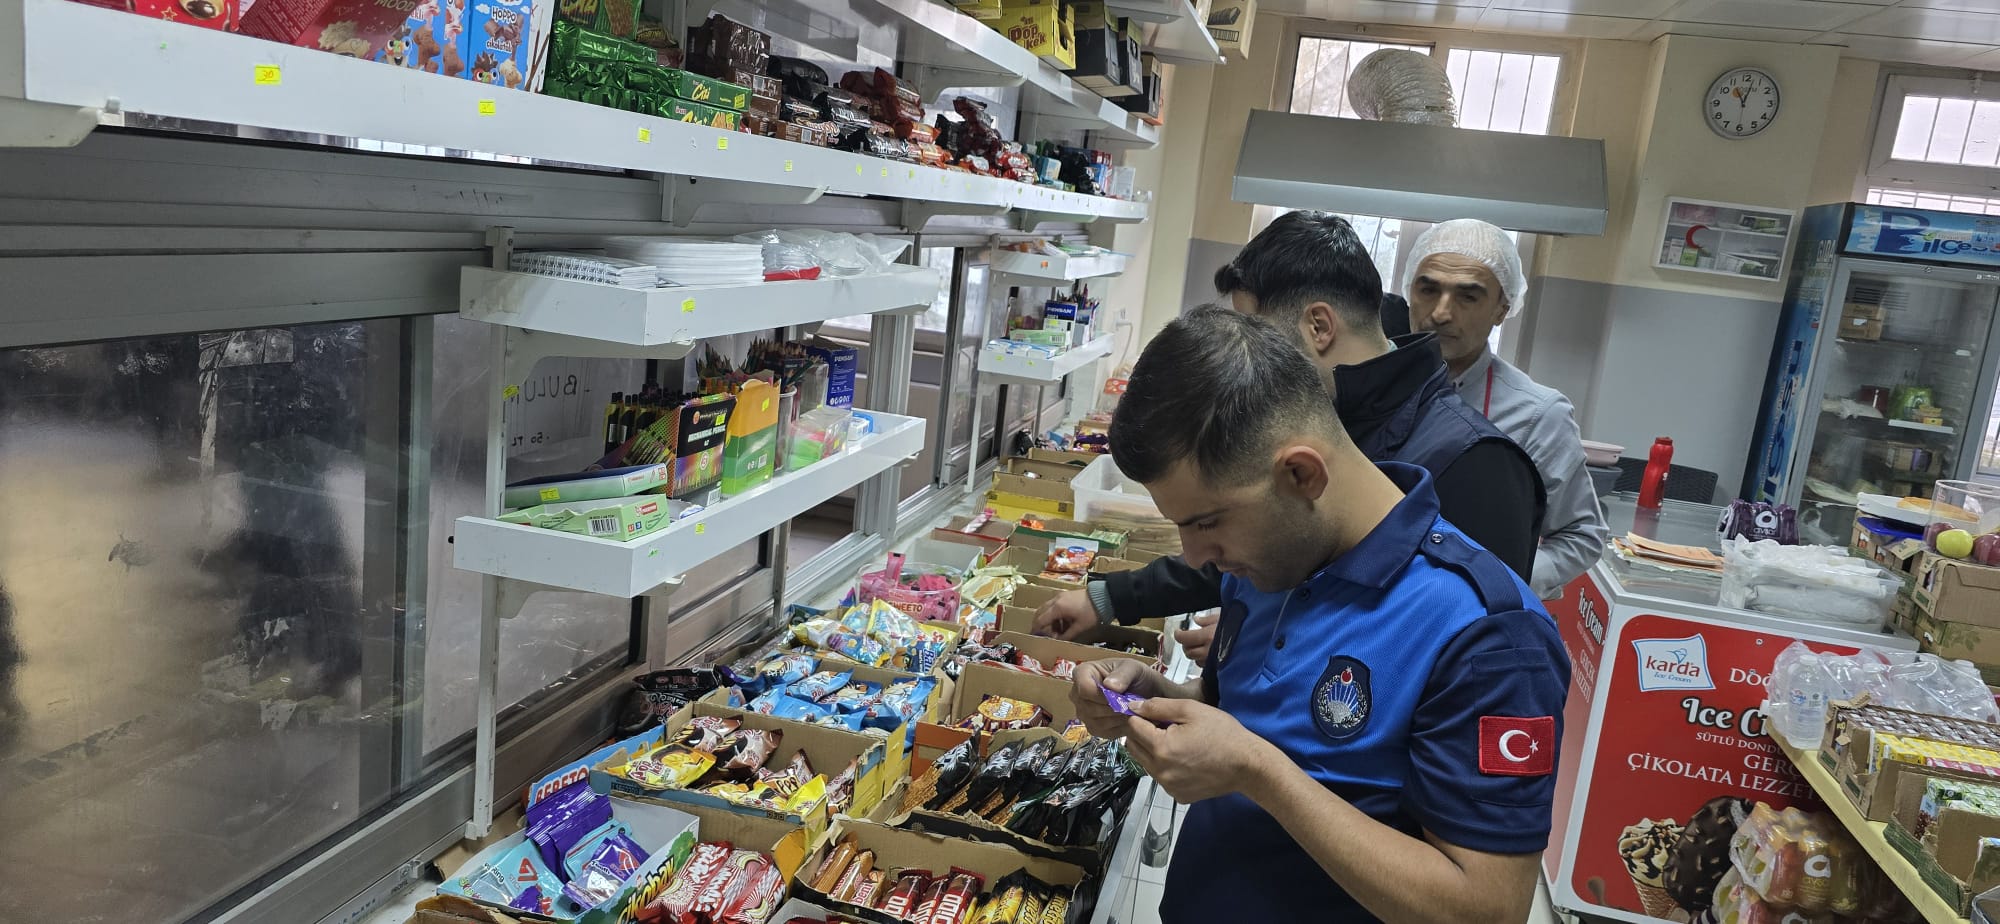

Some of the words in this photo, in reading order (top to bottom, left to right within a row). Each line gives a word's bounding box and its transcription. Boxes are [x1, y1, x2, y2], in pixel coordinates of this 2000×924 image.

[1730, 78, 1736, 86] 11
[1736, 124, 1743, 132] 6
[1646, 655, 1701, 678] karda
[1667, 674, 1692, 683] Cream
[1681, 696, 1734, 730] Ice
[1696, 731, 1735, 746] SÜTLÜ
[1743, 754, 1802, 779] GERÇ
[1627, 752, 1734, 786] ÇİKOLATA
[1740, 773, 1816, 801] LEZZET
